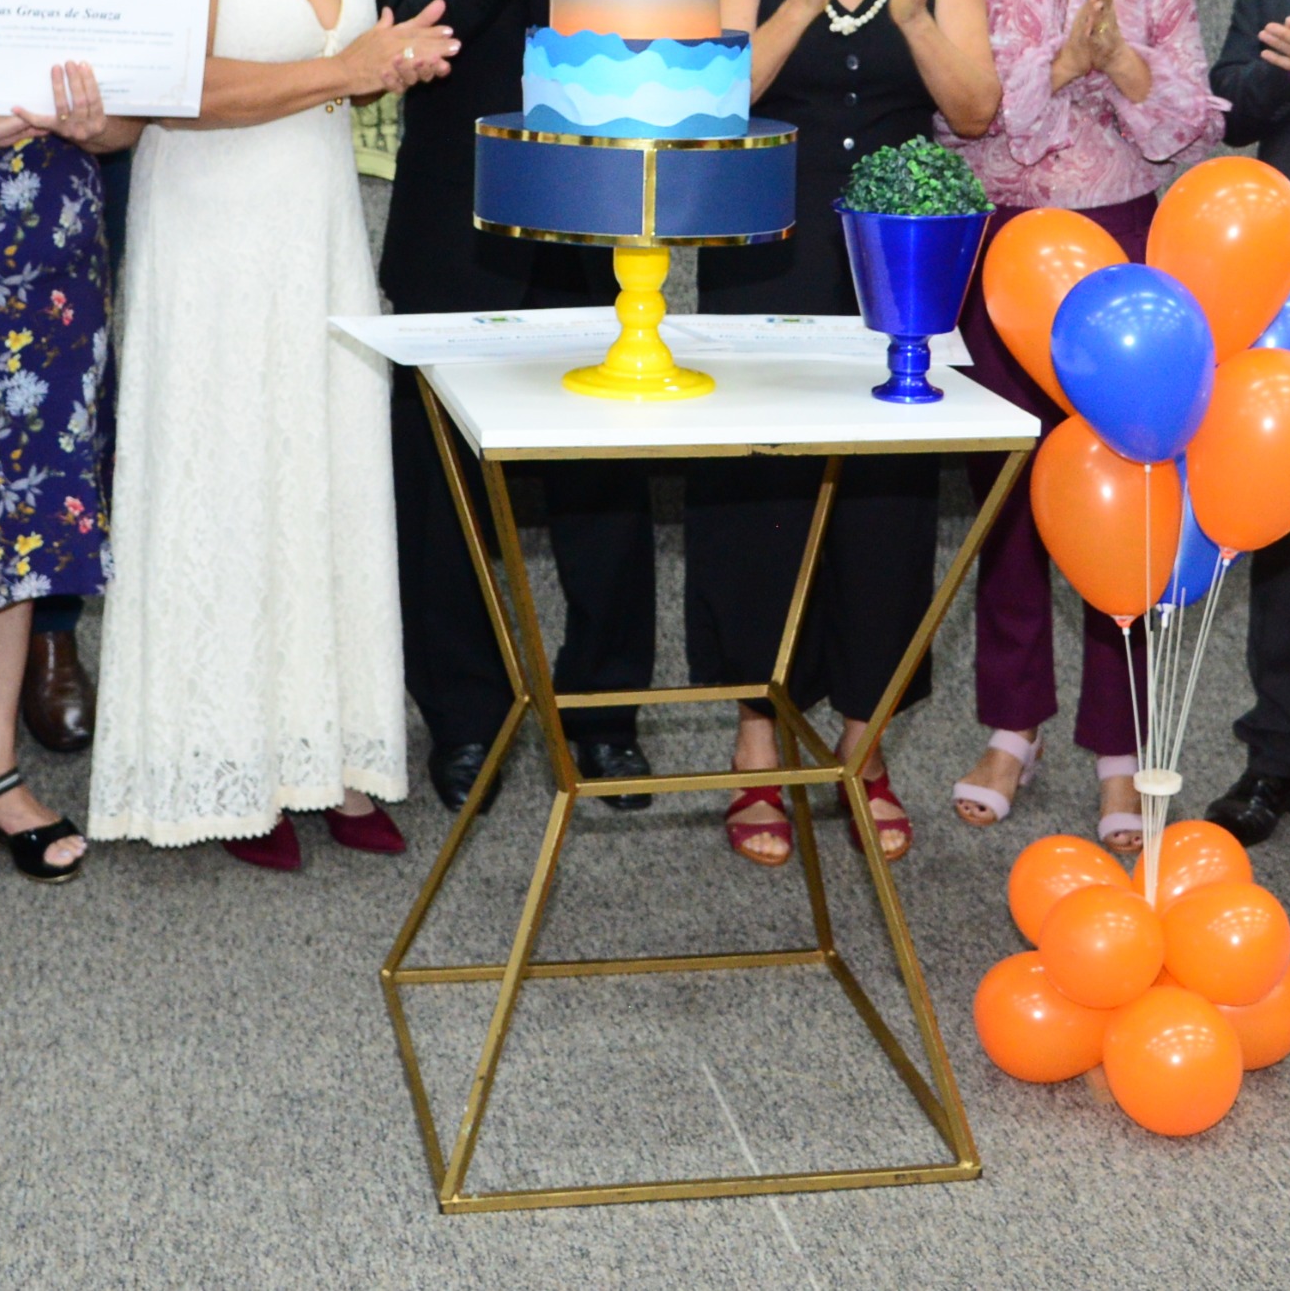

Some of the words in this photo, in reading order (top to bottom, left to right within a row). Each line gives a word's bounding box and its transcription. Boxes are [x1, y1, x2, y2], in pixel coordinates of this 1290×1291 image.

[16, 5, 61, 20] Graças
[65, 7, 80, 19] de
[85, 8, 122, 21] Souza
